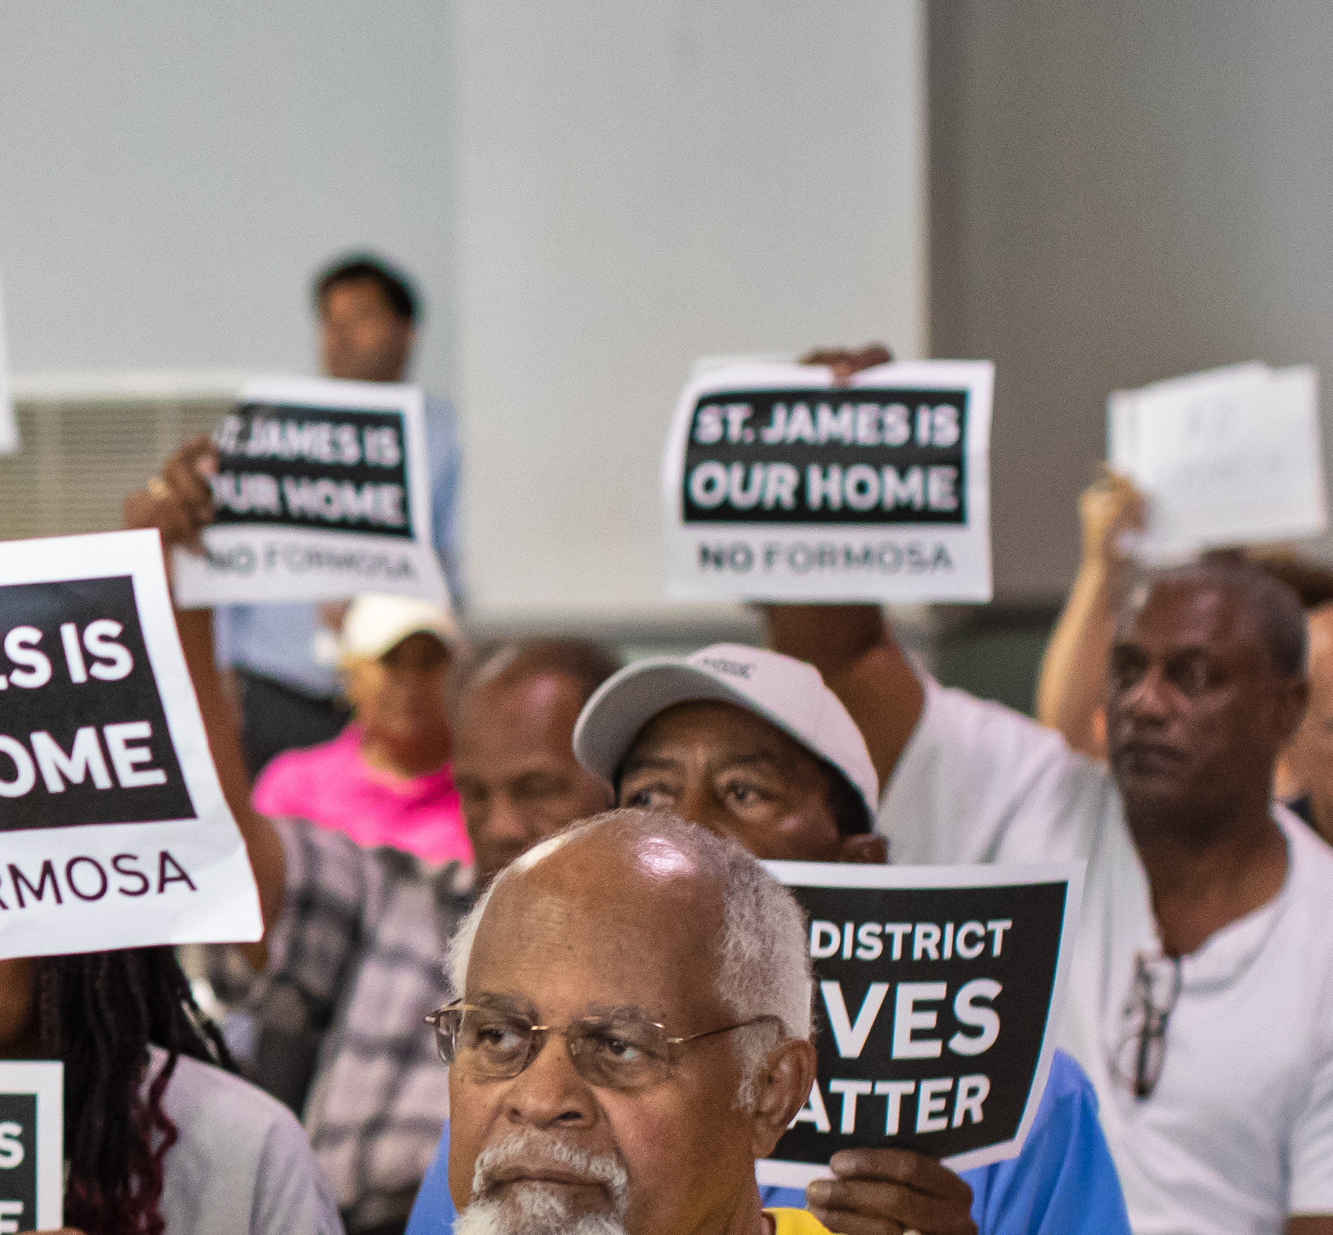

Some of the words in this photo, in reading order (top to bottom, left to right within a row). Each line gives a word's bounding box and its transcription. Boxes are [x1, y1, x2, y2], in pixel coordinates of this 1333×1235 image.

[246, 415, 360, 466] JAMES
[363, 425, 402, 471] IS
[695, 402, 754, 445] ST.
[760, 402, 910, 446] JAMES
[915, 404, 960, 448] IS
[283, 474, 406, 527] HOME
[689, 461, 799, 510] OUR
[806, 463, 958, 512] HOME
[699, 541, 754, 574] NO
[763, 541, 954, 575] FORMOSA
[60, 618, 134, 684] IS
[809, 919, 1012, 961] DISTRICT
